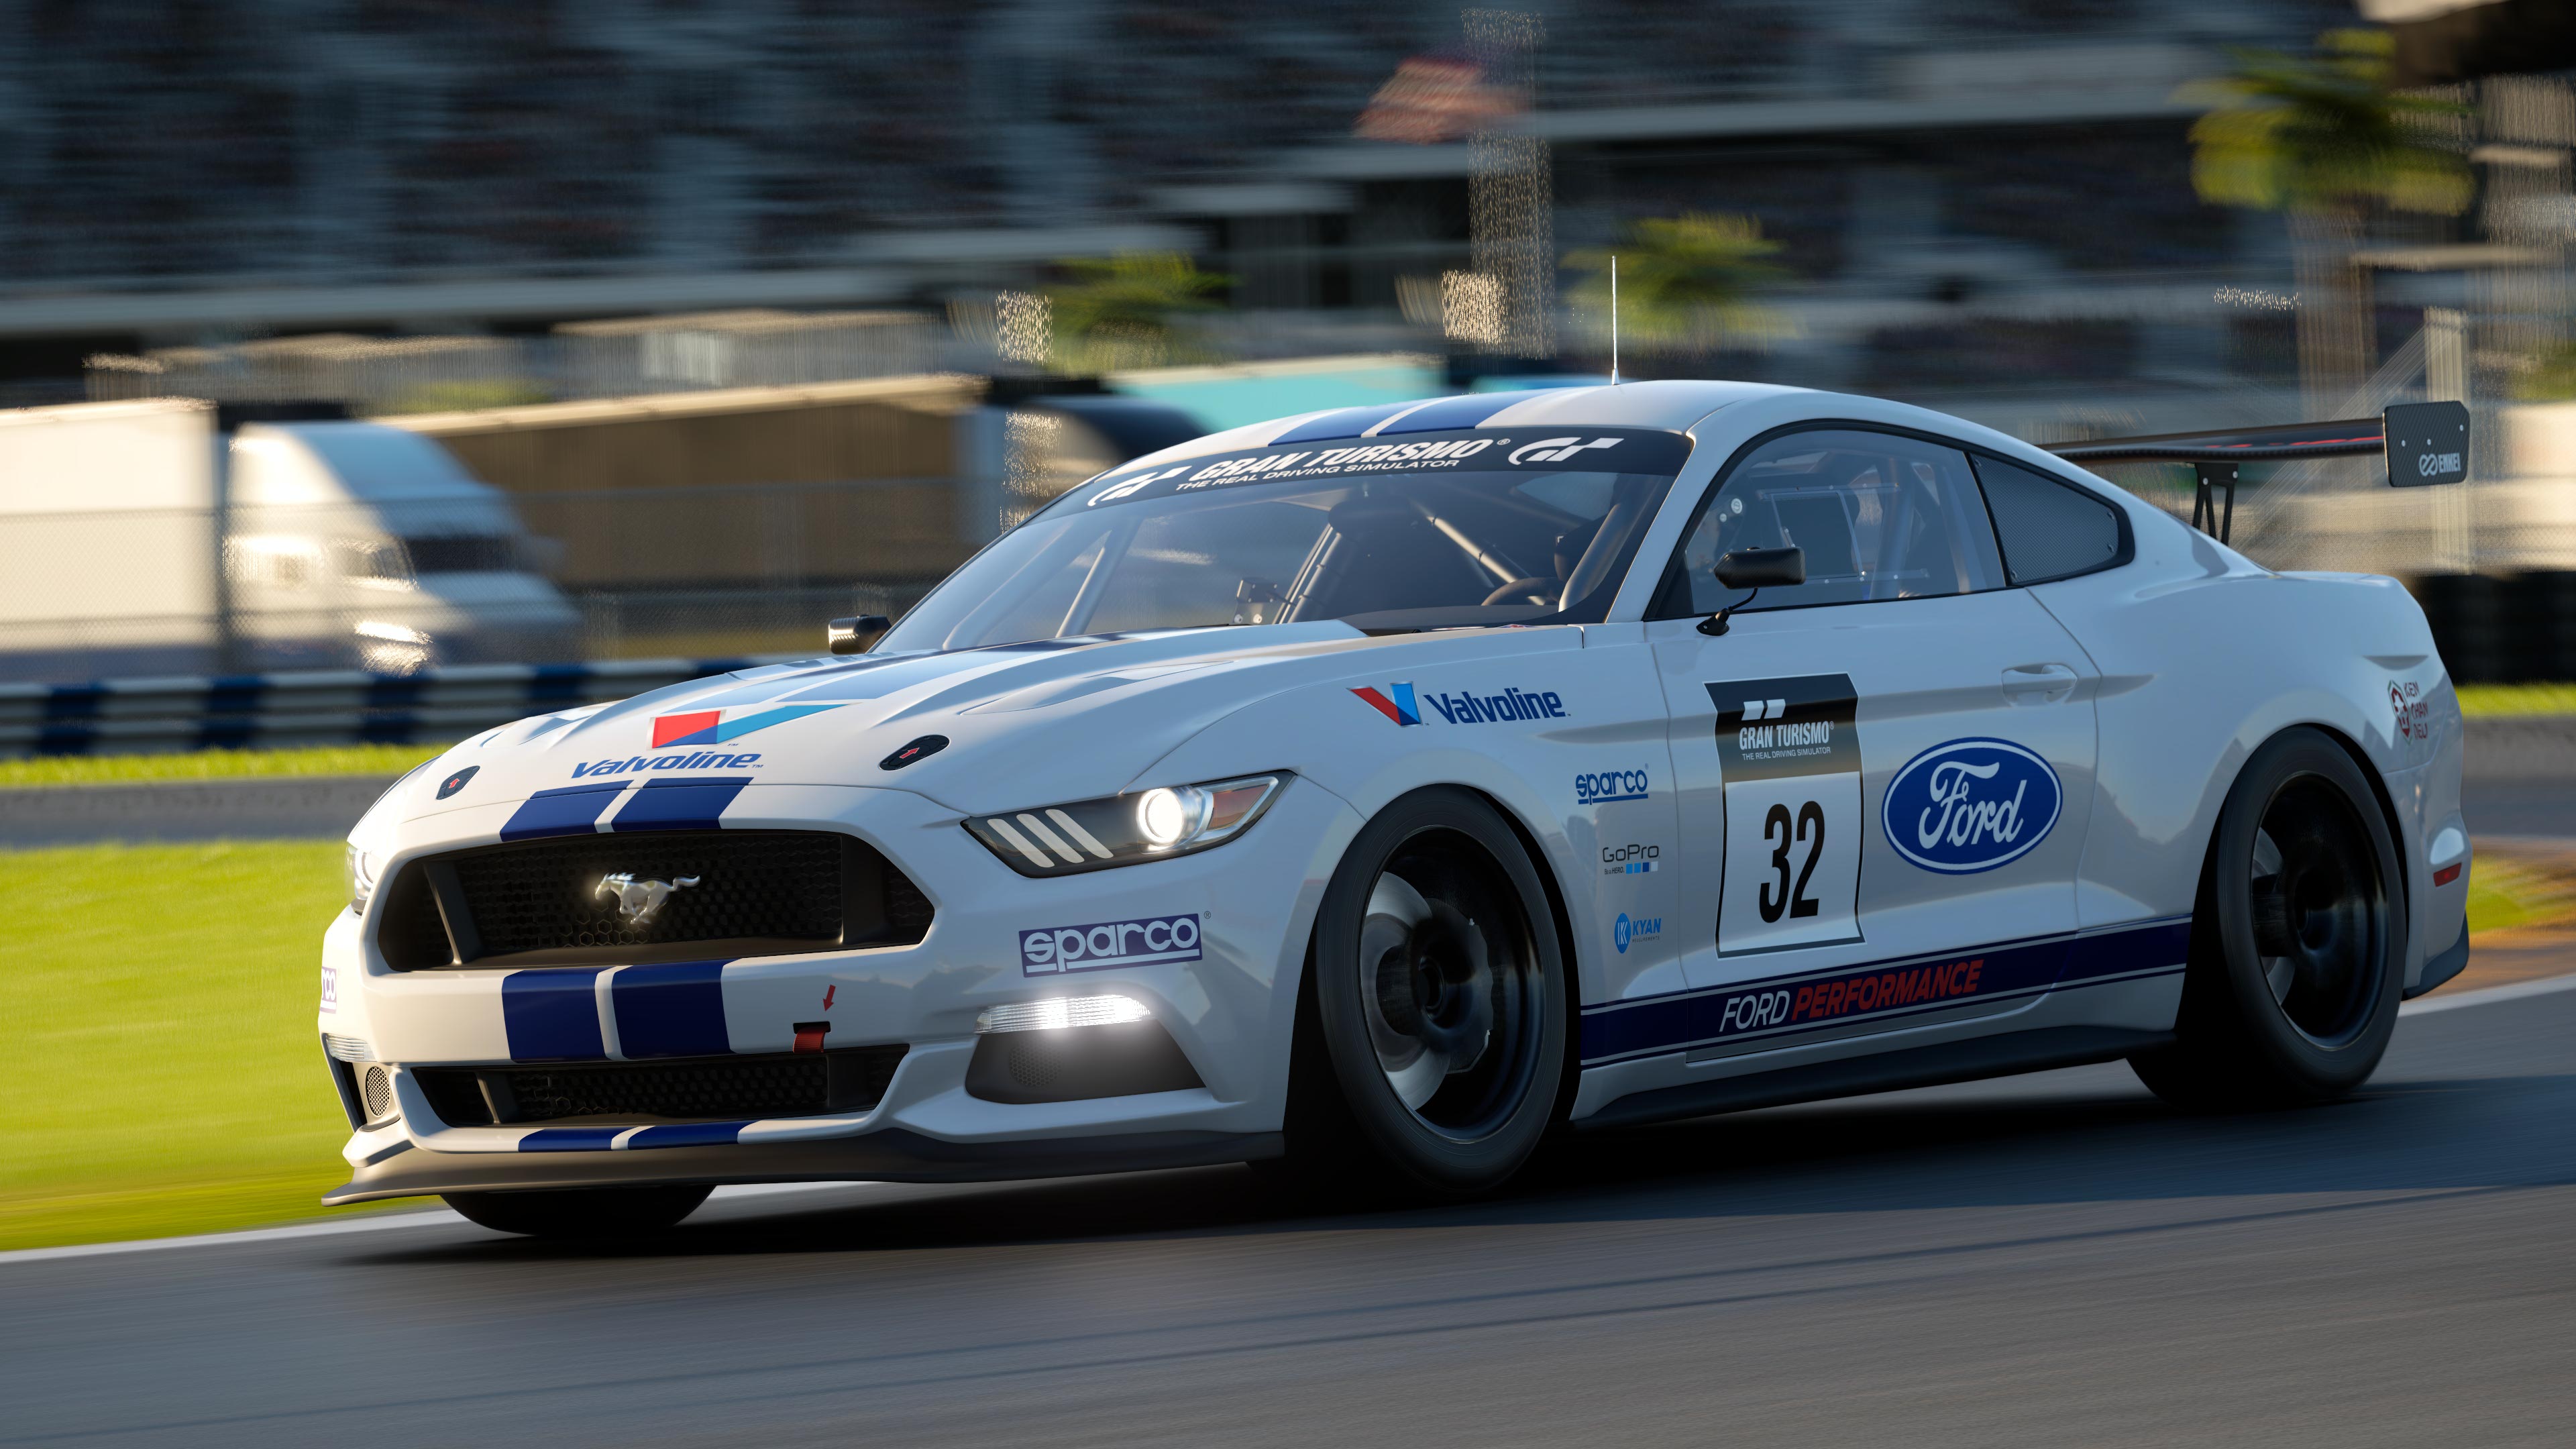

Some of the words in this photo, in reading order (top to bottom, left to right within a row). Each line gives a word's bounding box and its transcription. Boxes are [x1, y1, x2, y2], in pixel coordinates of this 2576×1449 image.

[1176, 480, 1211, 490] THE
[1212, 474, 1257, 486] REAL
[1263, 466, 1340, 480] DRIVING
[1344, 460, 1459, 472] SIMULATOR
[1189, 451, 1313, 482] GRAN
[1739, 726, 1773, 750] GRAN
[1742, 753, 1754, 761] THE
[1755, 751, 1771, 759] REAL
[1772, 749, 1796, 758] DRIVING
[1797, 747, 1831, 757] SIMULATOR
[1918, 761, 2027, 849] Ford
[1603, 844, 1659, 863] GoPro
[1759, 801, 1825, 924] 32
[1632, 918, 1662, 936] KYAN
[1719, 991, 1790, 1032] FORD
[1791, 959, 1984, 1021] PERFORMANCE
